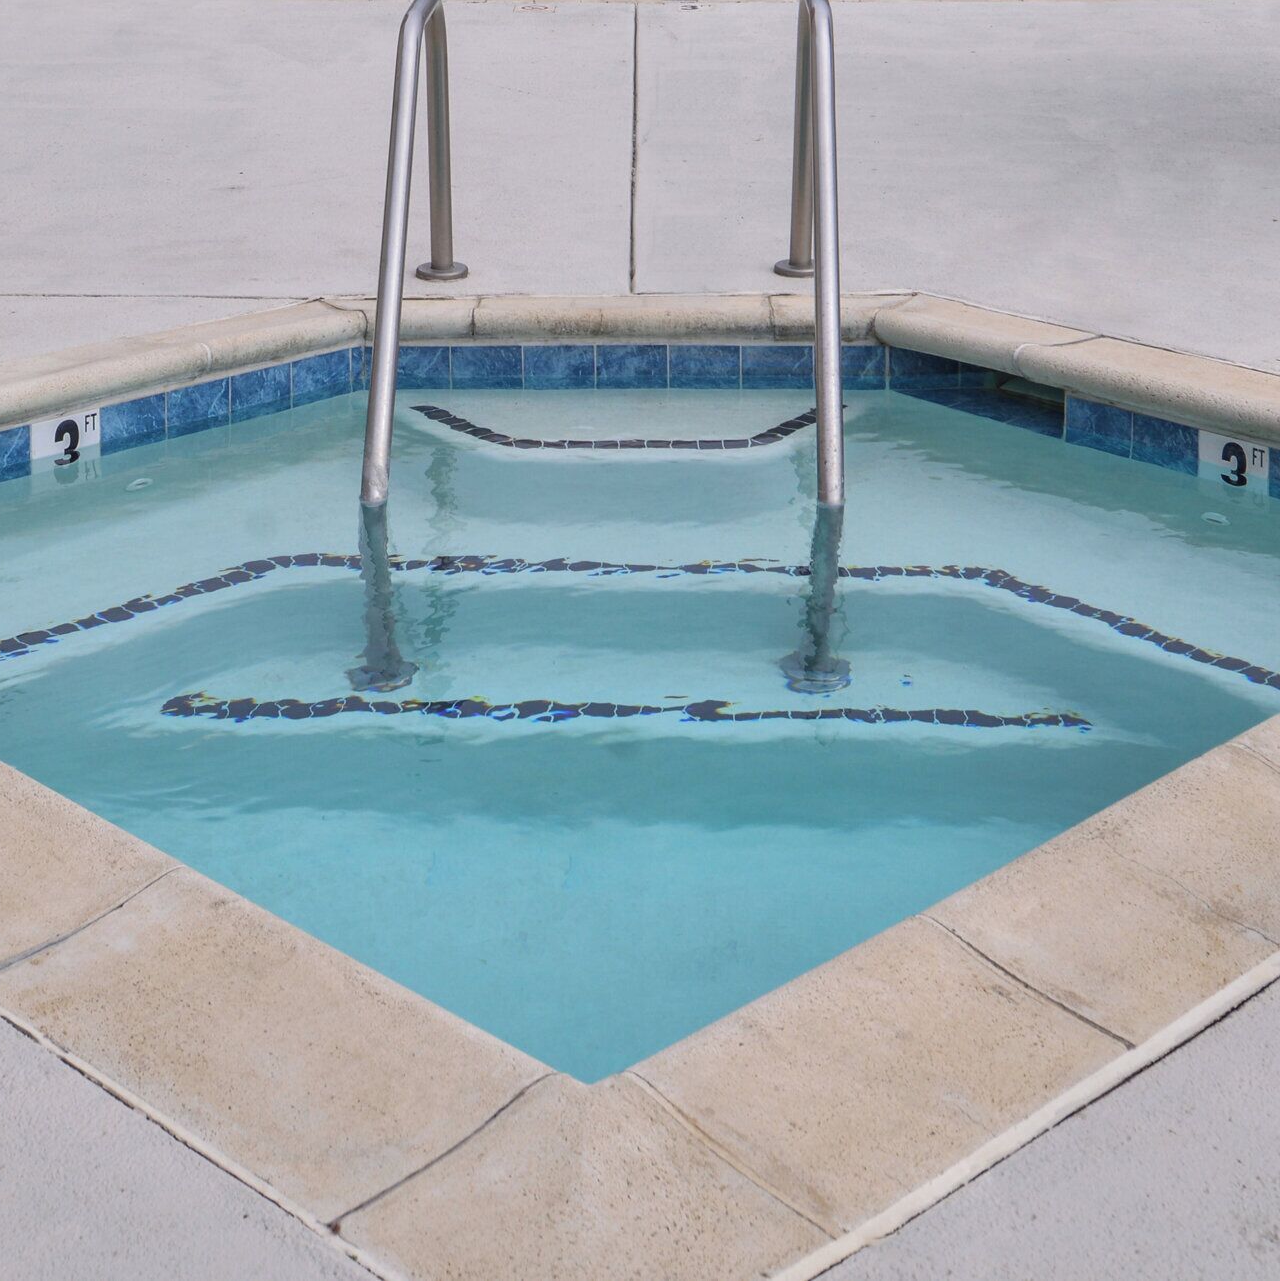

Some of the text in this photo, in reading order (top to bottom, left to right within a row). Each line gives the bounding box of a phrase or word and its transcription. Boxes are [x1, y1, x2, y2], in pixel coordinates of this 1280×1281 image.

[54, 413, 97, 466] 3 FT
[1221, 442, 1266, 487] 3 FT
